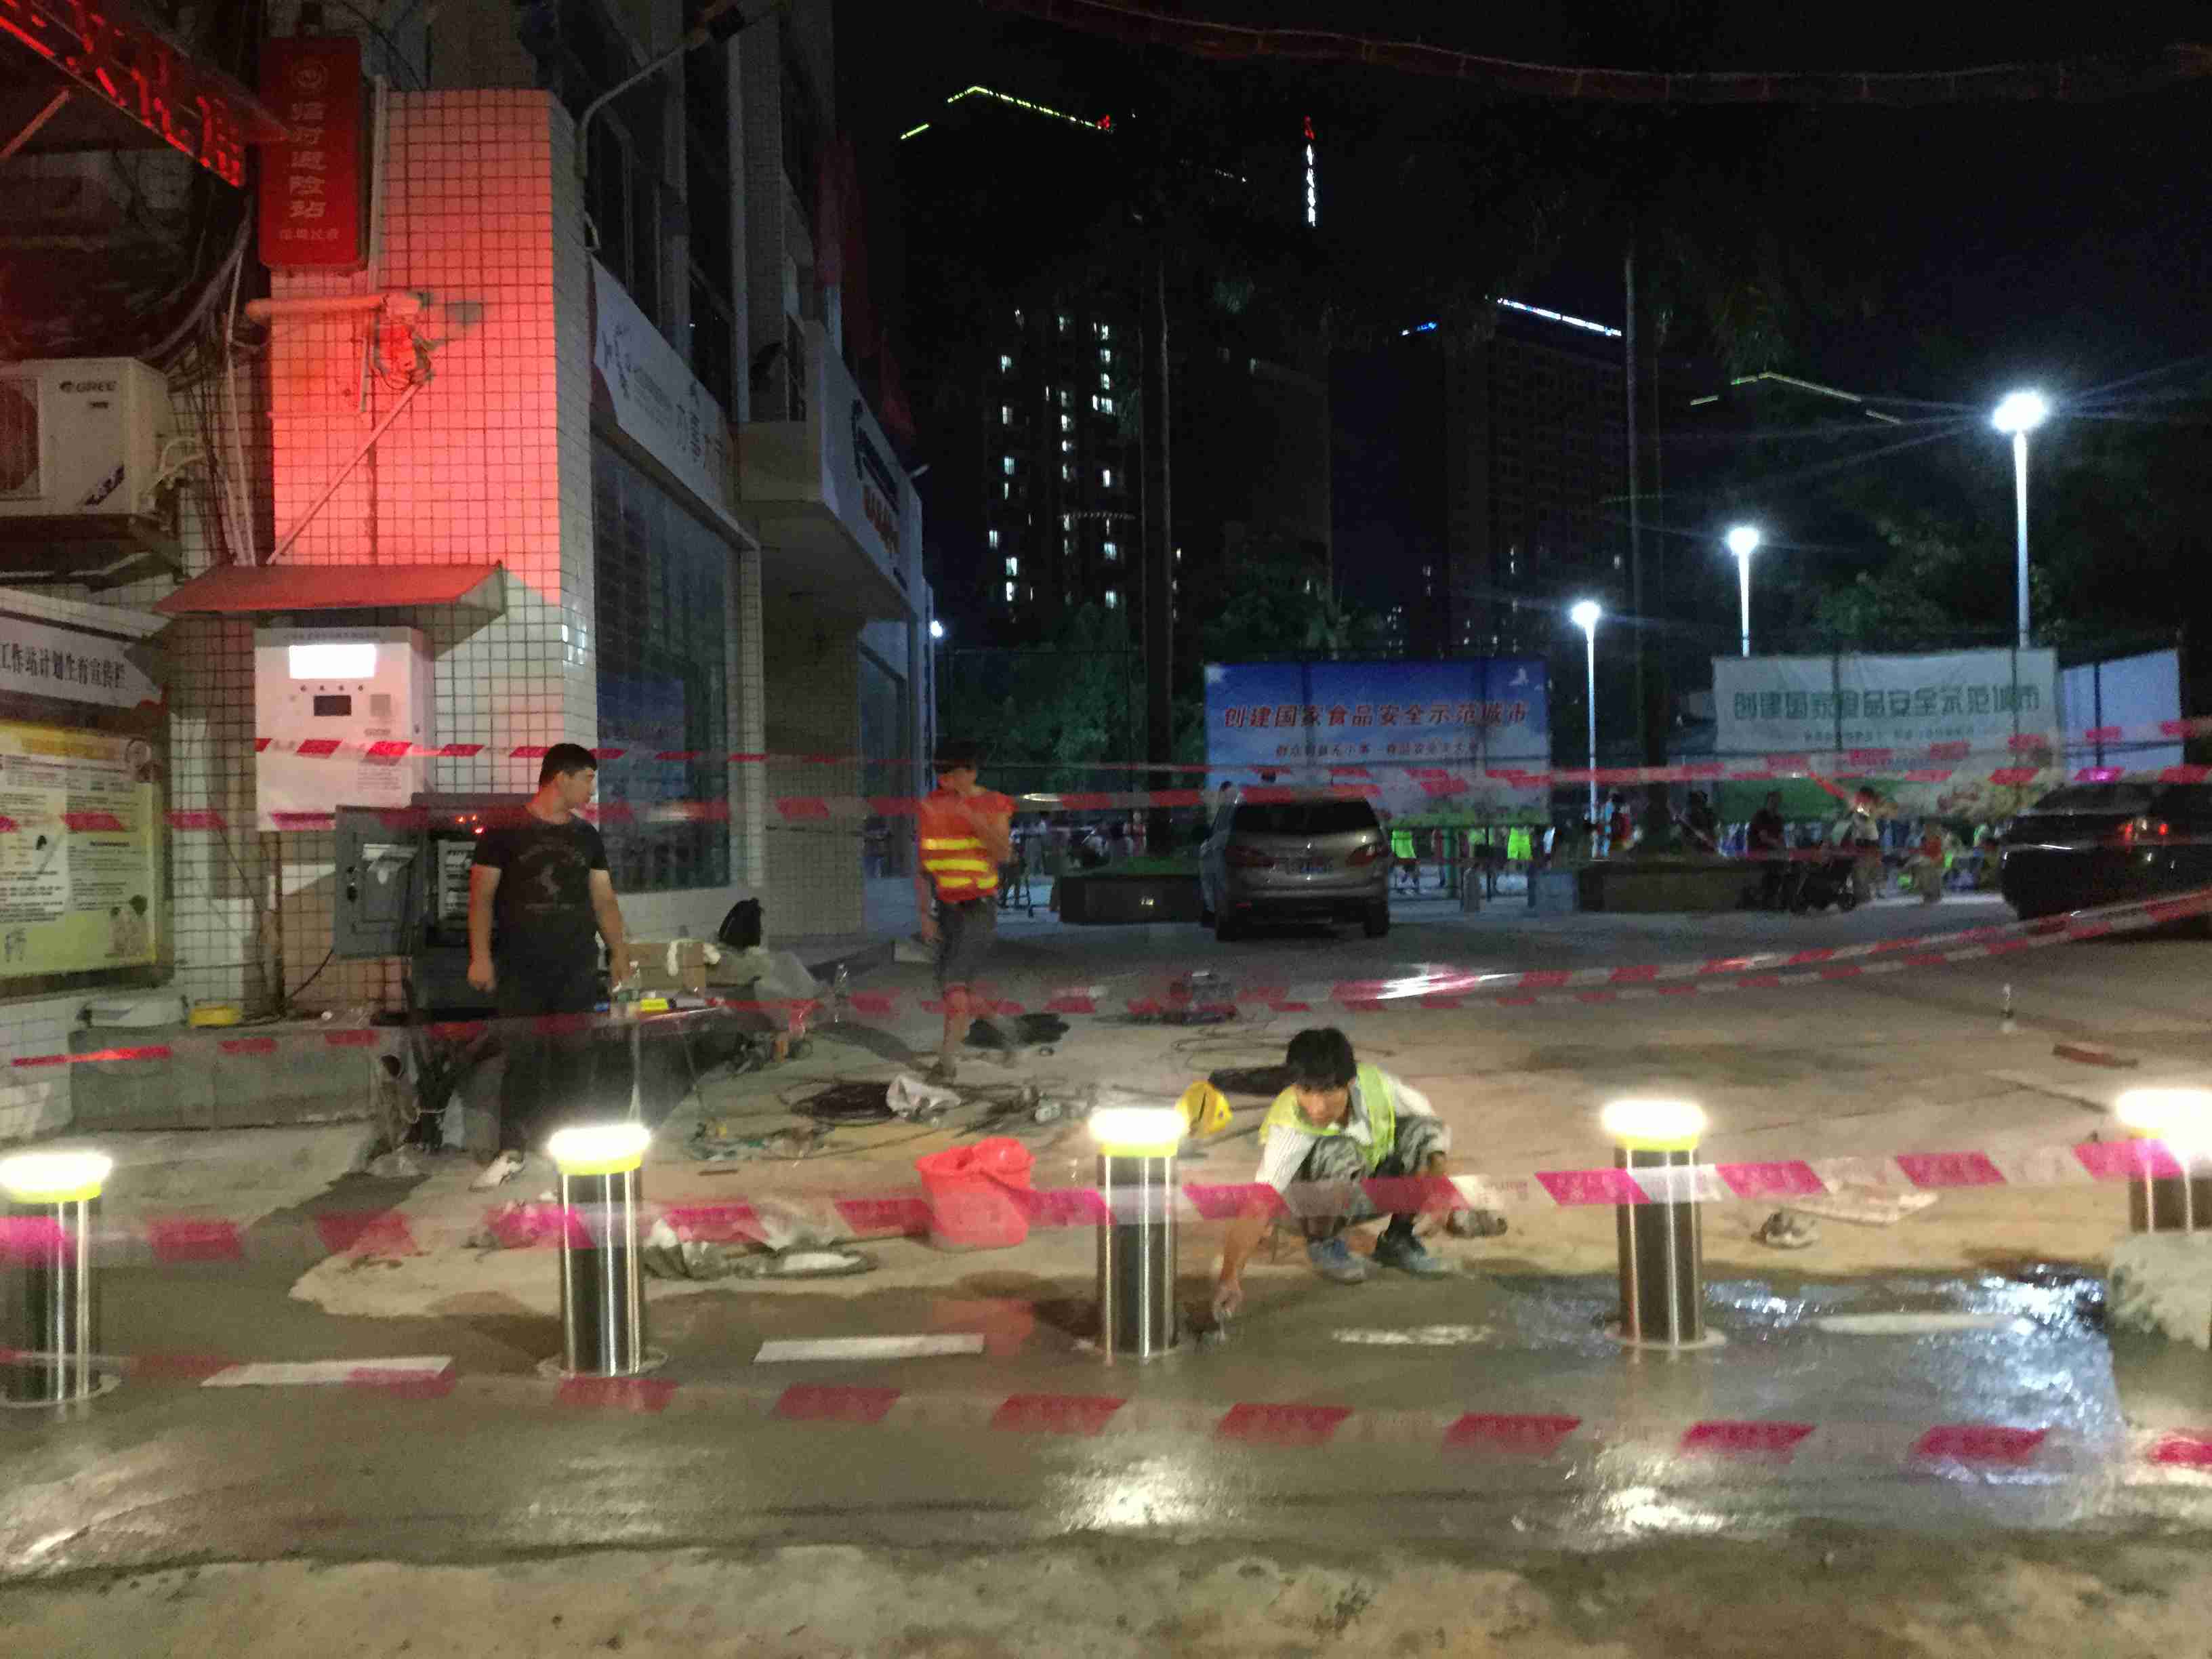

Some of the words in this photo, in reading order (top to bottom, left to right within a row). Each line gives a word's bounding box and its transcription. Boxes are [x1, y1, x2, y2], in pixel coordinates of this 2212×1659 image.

[1224, 702, 1528, 729] 创建国家食品安全示范城市
